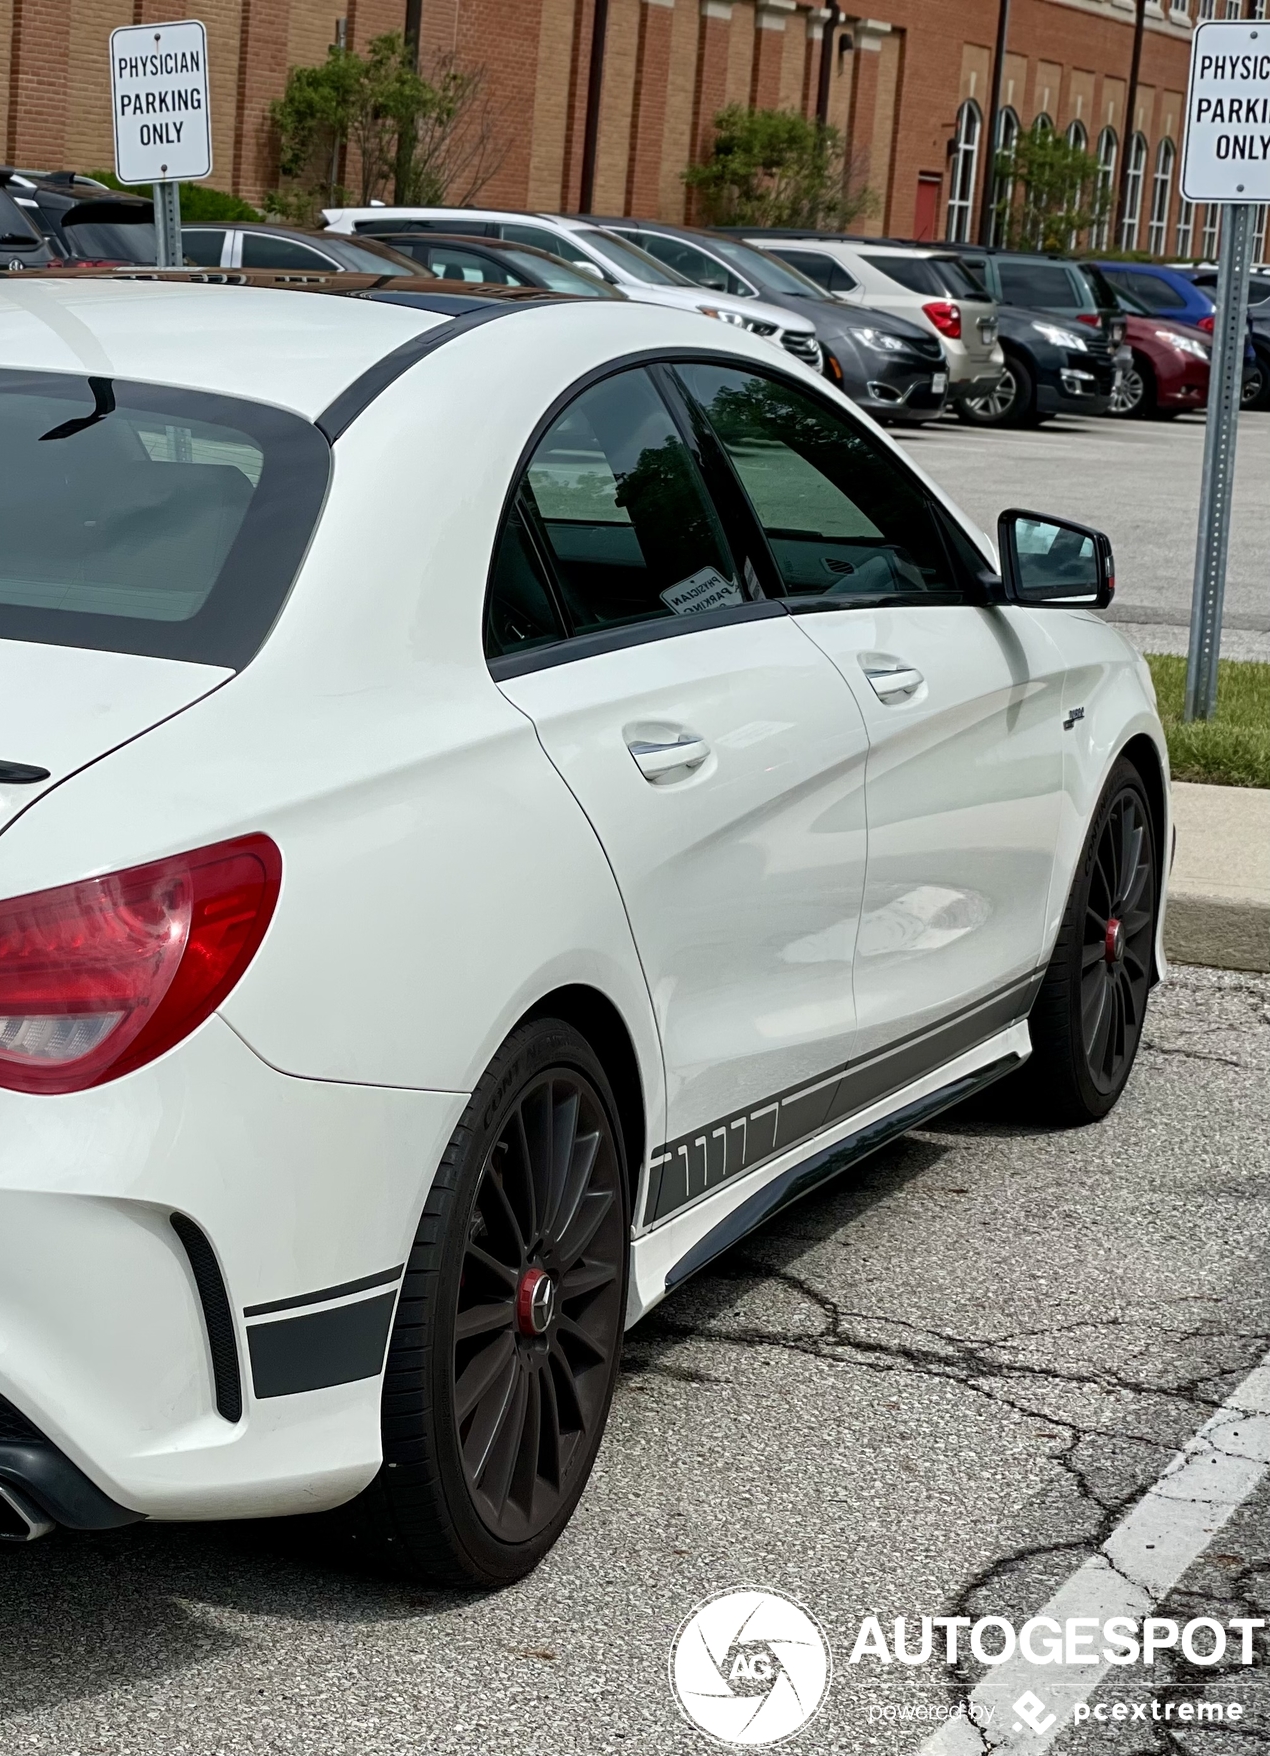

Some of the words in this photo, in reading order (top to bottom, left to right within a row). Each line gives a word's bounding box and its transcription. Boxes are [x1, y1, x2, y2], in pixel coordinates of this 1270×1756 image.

[118, 51, 200, 79] PHYSICIAN
[120, 88, 201, 116] PARKING
[1196, 98, 1270, 123] PARKI
[140, 121, 183, 146] ONLY
[1216, 134, 1270, 160] ONLY
